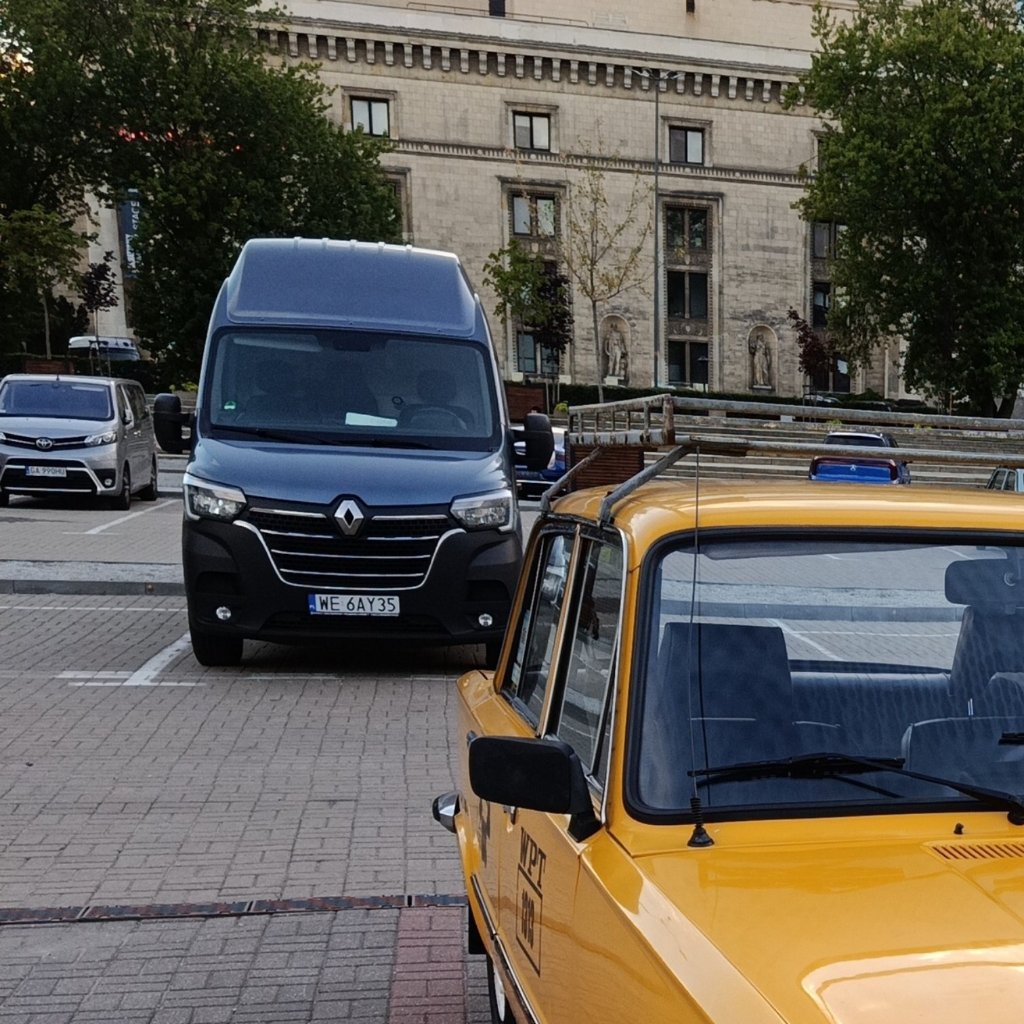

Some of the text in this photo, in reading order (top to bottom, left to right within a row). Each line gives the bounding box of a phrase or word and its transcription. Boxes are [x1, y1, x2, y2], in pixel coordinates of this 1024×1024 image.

[319, 596, 396, 612] WE 6AY35
[520, 826, 547, 890] WPT
